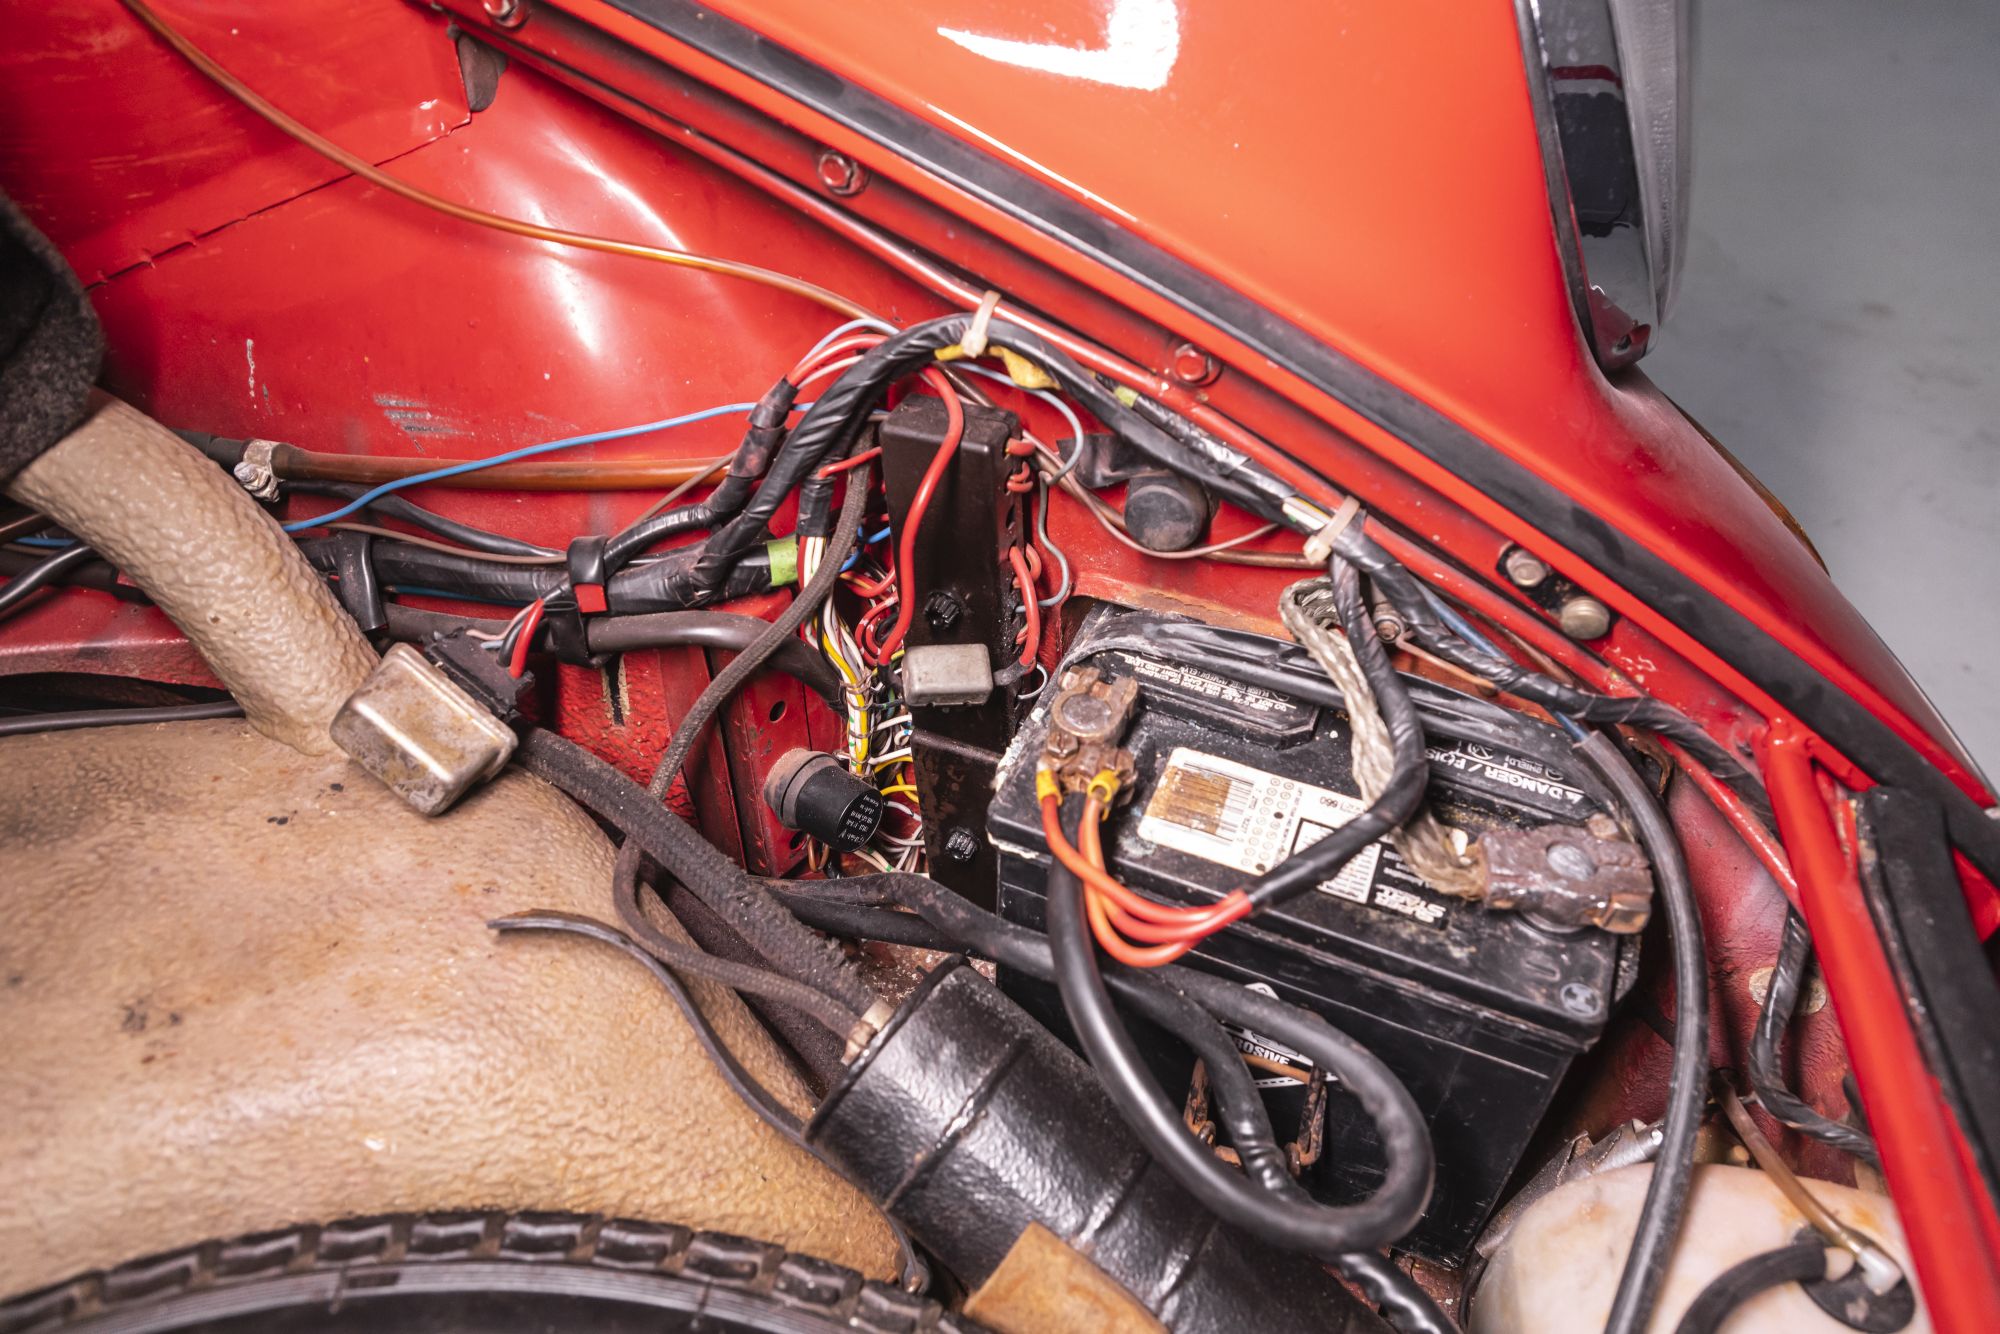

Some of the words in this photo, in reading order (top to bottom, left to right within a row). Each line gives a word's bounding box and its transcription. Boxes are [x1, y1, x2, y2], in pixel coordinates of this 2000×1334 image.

[1425, 749, 1467, 770] POIS
[1484, 765, 1563, 800] DANGER
[1237, 1037, 1290, 1065] ROSIVE
